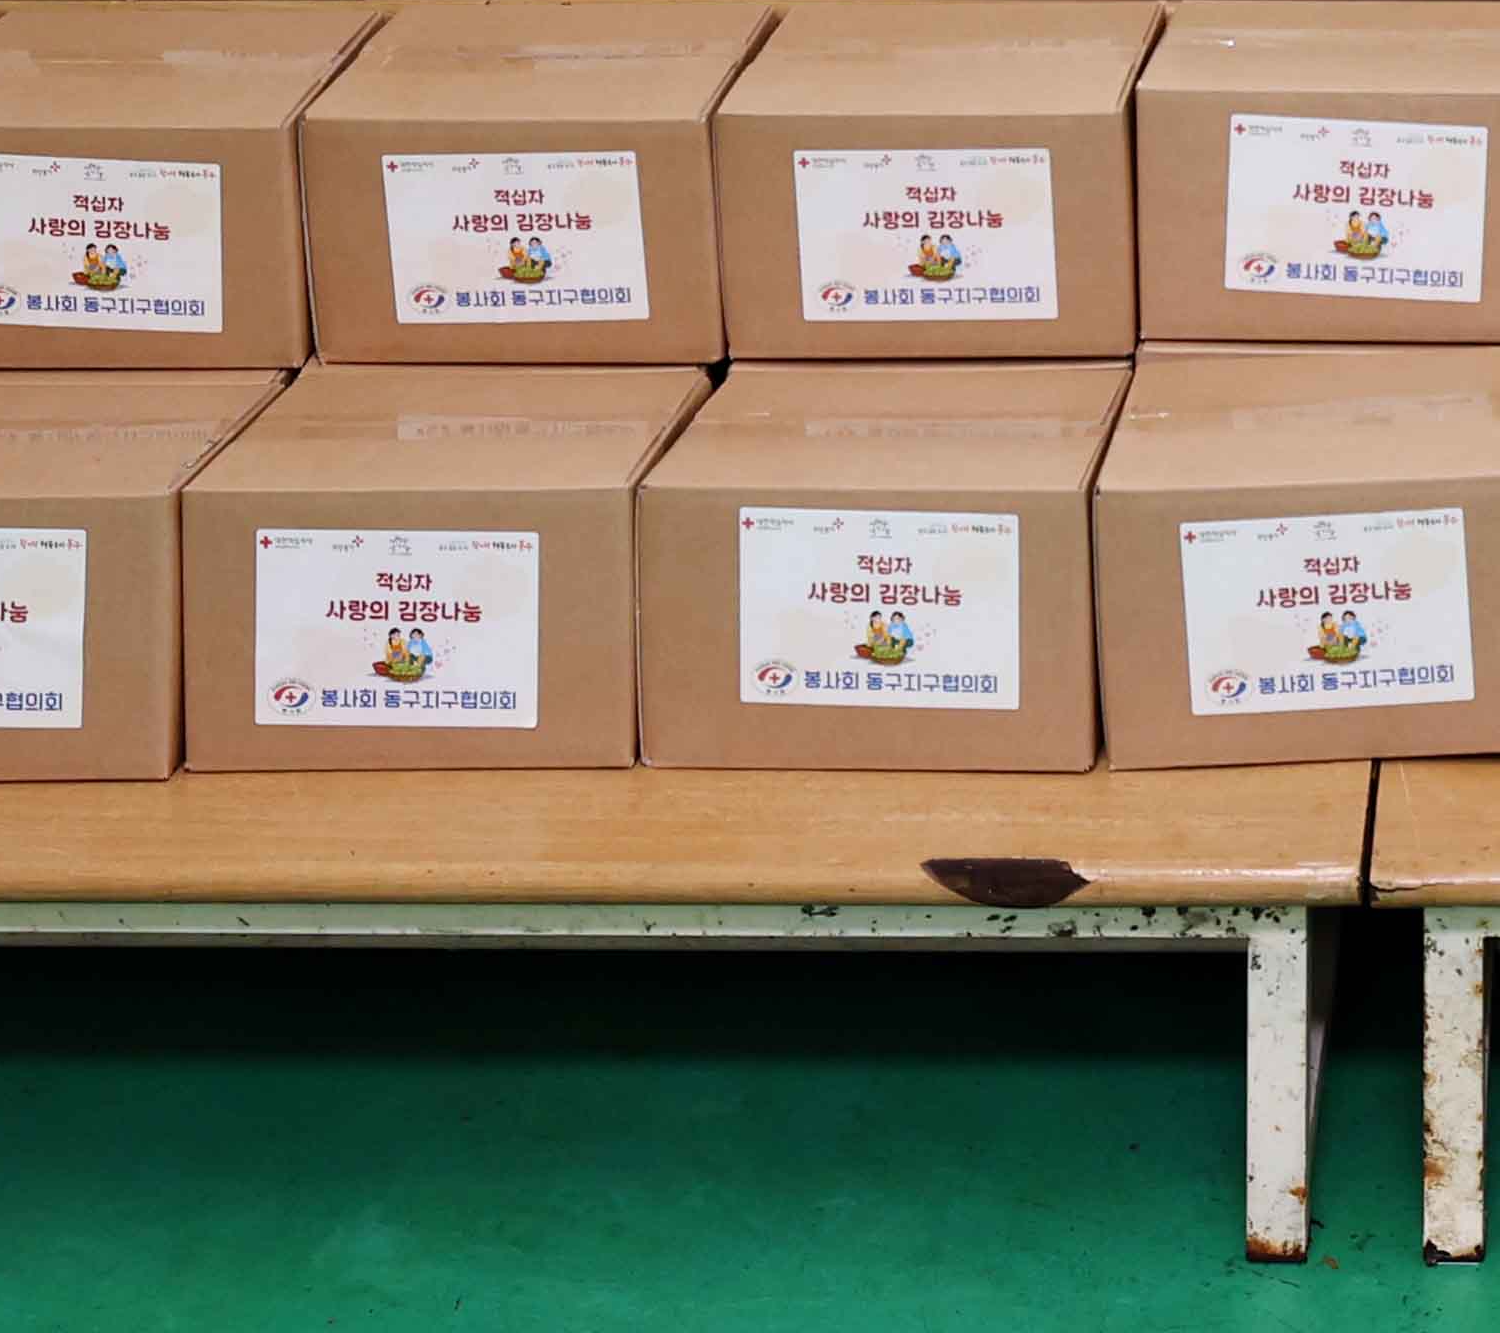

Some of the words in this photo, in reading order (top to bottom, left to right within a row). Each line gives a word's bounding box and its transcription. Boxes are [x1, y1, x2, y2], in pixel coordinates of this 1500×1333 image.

[73, 194, 125, 214] 적십자
[905, 186, 959, 204] 적십자
[27, 216, 87, 238] 사랑의
[93, 219, 171, 242] 김장나눔
[861, 210, 921, 231] 사랑의
[926, 210, 1006, 231] 김장나눔
[857, 554, 913, 576] 적십자
[1303, 554, 1363, 577] 적십자
[375, 571, 434, 593] 적십자
[807, 580, 871, 605] 사랑의
[877, 582, 963, 608] 김장나눔
[1254, 584, 1321, 610] 사랑의
[1327, 579, 1415, 606] 김장나눔
[325, 599, 390, 622] 사랑의
[397, 599, 484, 624] 김장나눔
[803, 669, 861, 693] 봉사회
[865, 671, 1001, 697] 동구지구협의회
[1256, 672, 1316, 697] 봉사회
[1319, 664, 1457, 693] 동구지구협의회
[321, 687, 379, 710] 봉사회
[384, 688, 521, 712] 동구지구협의회
